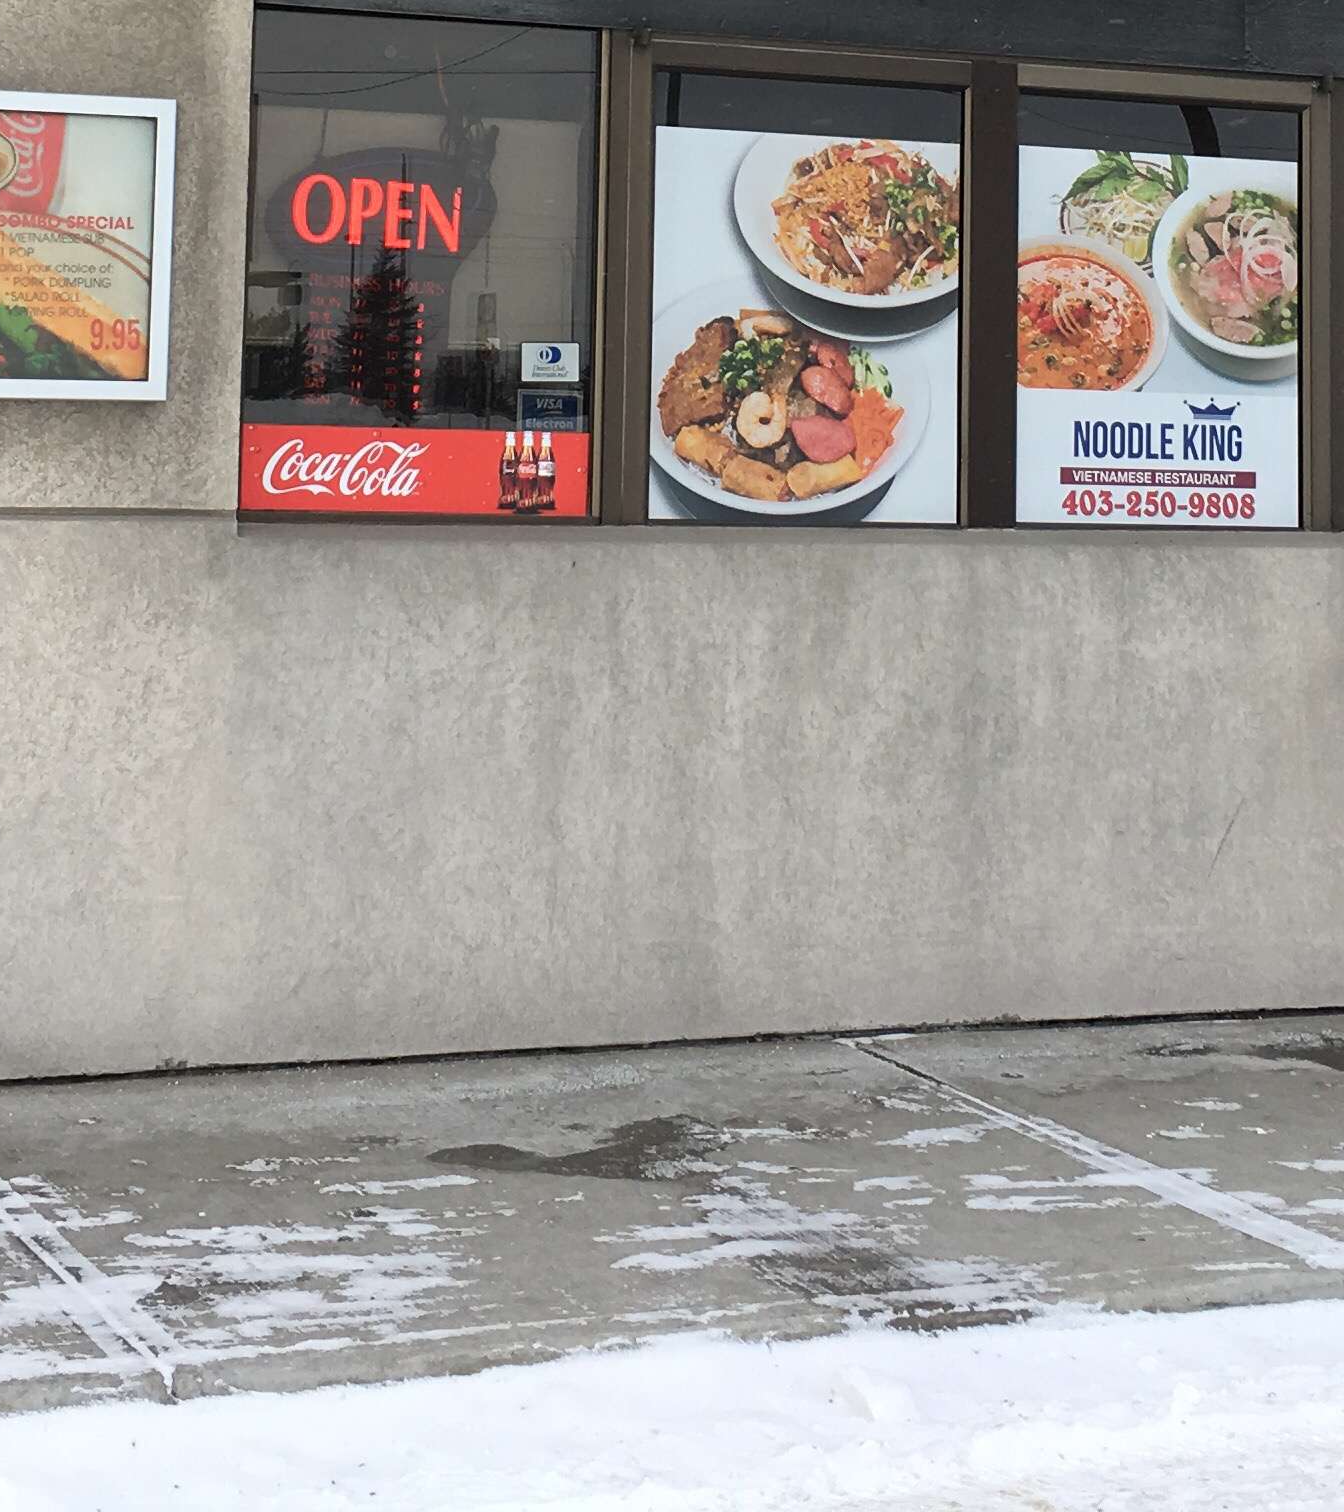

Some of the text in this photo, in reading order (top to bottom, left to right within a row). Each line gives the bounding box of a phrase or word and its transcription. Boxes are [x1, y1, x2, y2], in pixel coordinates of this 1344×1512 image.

[291, 173, 463, 253] OPEN
[67, 216, 135, 230] SPECIAL
[10, 231, 81, 244] VIETNAMESE
[83, 233, 106, 244] SUB
[9, 247, 35, 257] POP
[25, 263, 52, 275] your
[55, 262, 97, 274] choice
[49, 277, 112, 289] DUMPLING
[90, 317, 142, 351] 9.95
[536, 398, 563, 409] VISA
[525, 417, 574, 430] Electron
[1073, 420, 1243, 462] NOODLE KING
[262, 438, 432, 497] Coca-Cola
[1072, 469, 1237, 486] VIETNAMESE RESTAURANT
[1061, 489, 1256, 520] 403-250-9808
